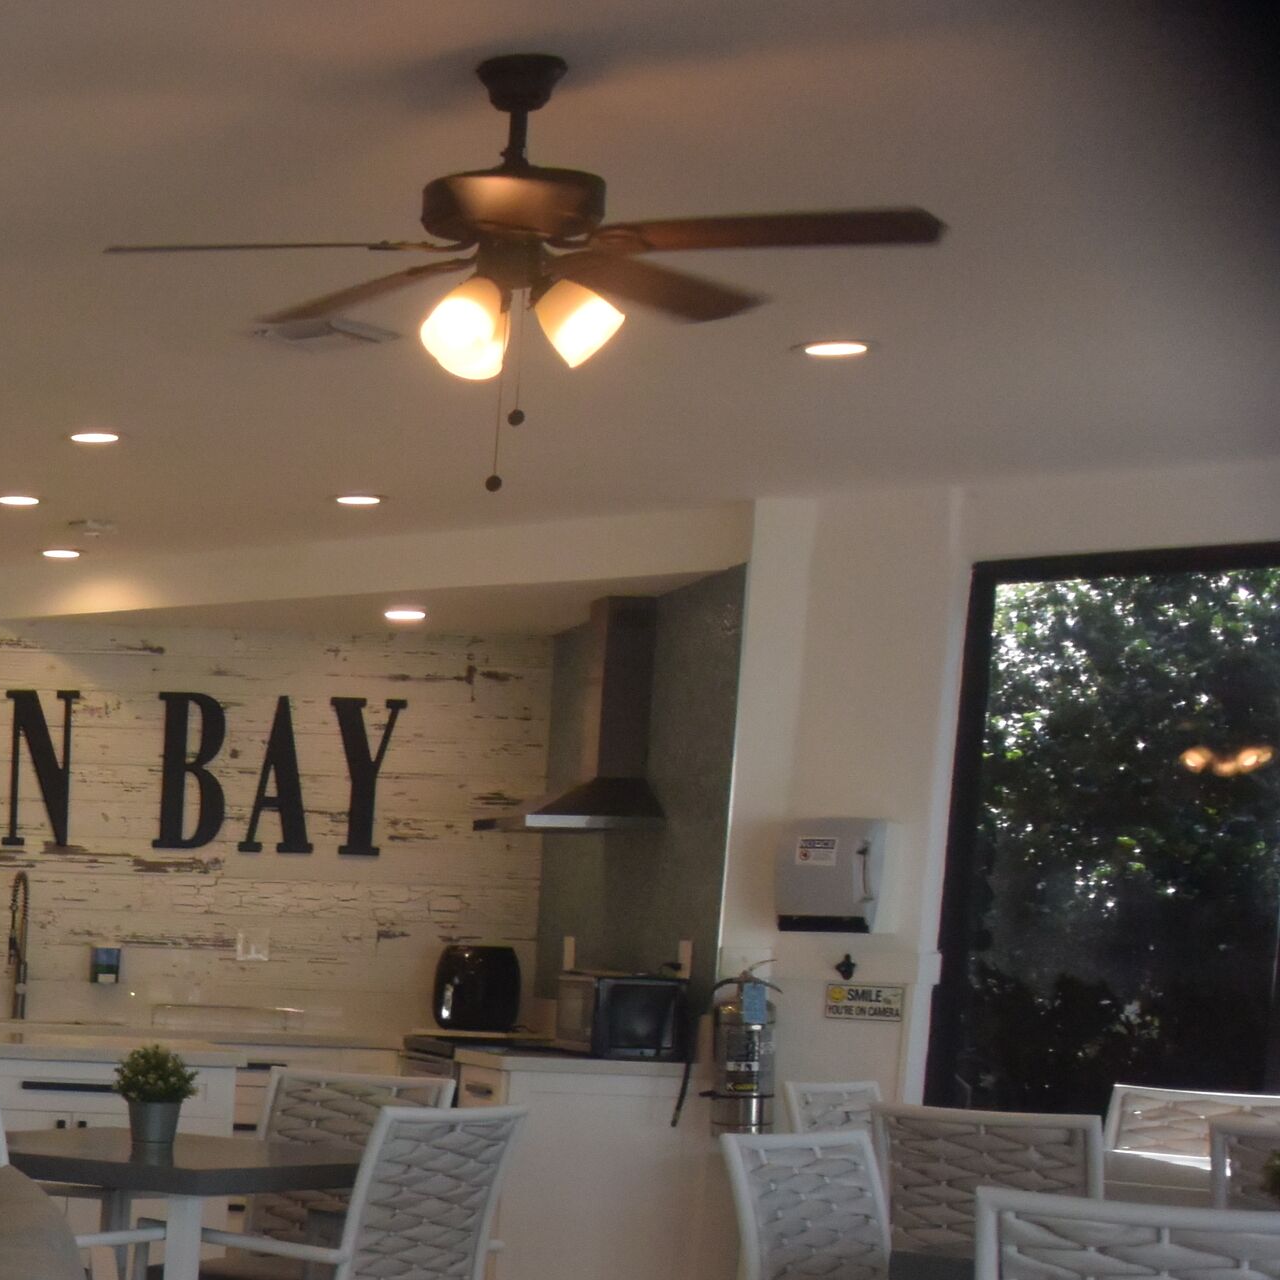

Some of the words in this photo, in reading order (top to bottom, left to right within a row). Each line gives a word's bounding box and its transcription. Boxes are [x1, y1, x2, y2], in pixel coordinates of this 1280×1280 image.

[151, 691, 408, 856] BAY
[847, 988, 882, 1003] SMILE
[855, 1006, 866, 1016] ON
[868, 1006, 900, 1018] CAMERA
